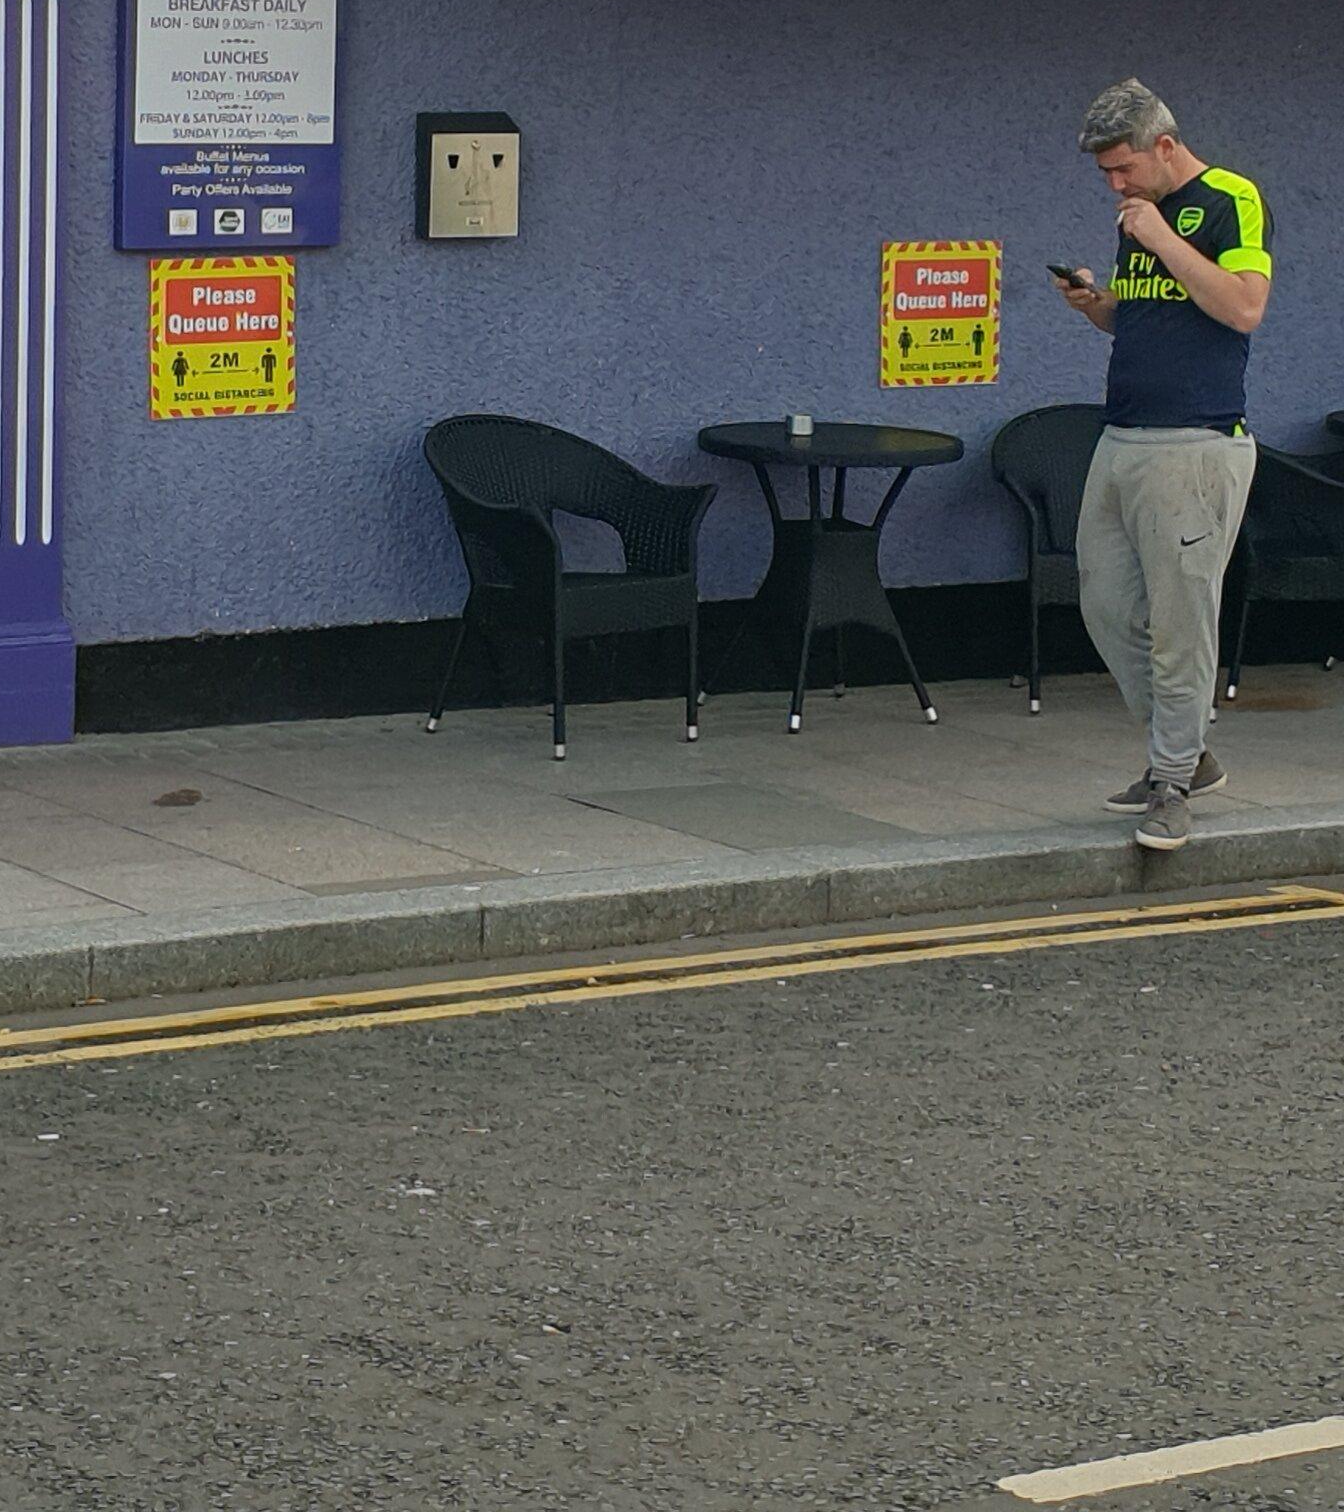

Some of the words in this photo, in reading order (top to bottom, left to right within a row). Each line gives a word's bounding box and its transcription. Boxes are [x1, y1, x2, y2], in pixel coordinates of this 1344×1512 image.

[263, 0, 307, 13] DAILY
[150, 16, 182, 29] MON
[192, 17, 219, 30] SUN
[203, 50, 269, 65] LUNCHES
[171, 71, 227, 83] MONDAY
[235, 71, 300, 83] THURSDAY
[139, 113, 181, 124] FRIDAY
[182, 113, 191, 124] &
[193, 113, 253, 124] SATURDAY
[172, 128, 219, 139] SUNDAY
[160, 163, 211, 176] available
[213, 163, 230, 174] for
[255, 164, 306, 175] occasion
[171, 184, 203, 198] Party
[241, 184, 293, 195] Available
[1129, 252, 1156, 275] Fly
[916, 268, 970, 285] Please
[192, 286, 256, 307] Please
[896, 292, 947, 311] Queue
[951, 291, 988, 308] Here
[168, 313, 230, 335] Queue
[235, 311, 279, 332] Here
[929, 328, 954, 342] 2M
[209, 352, 239, 368] 2M
